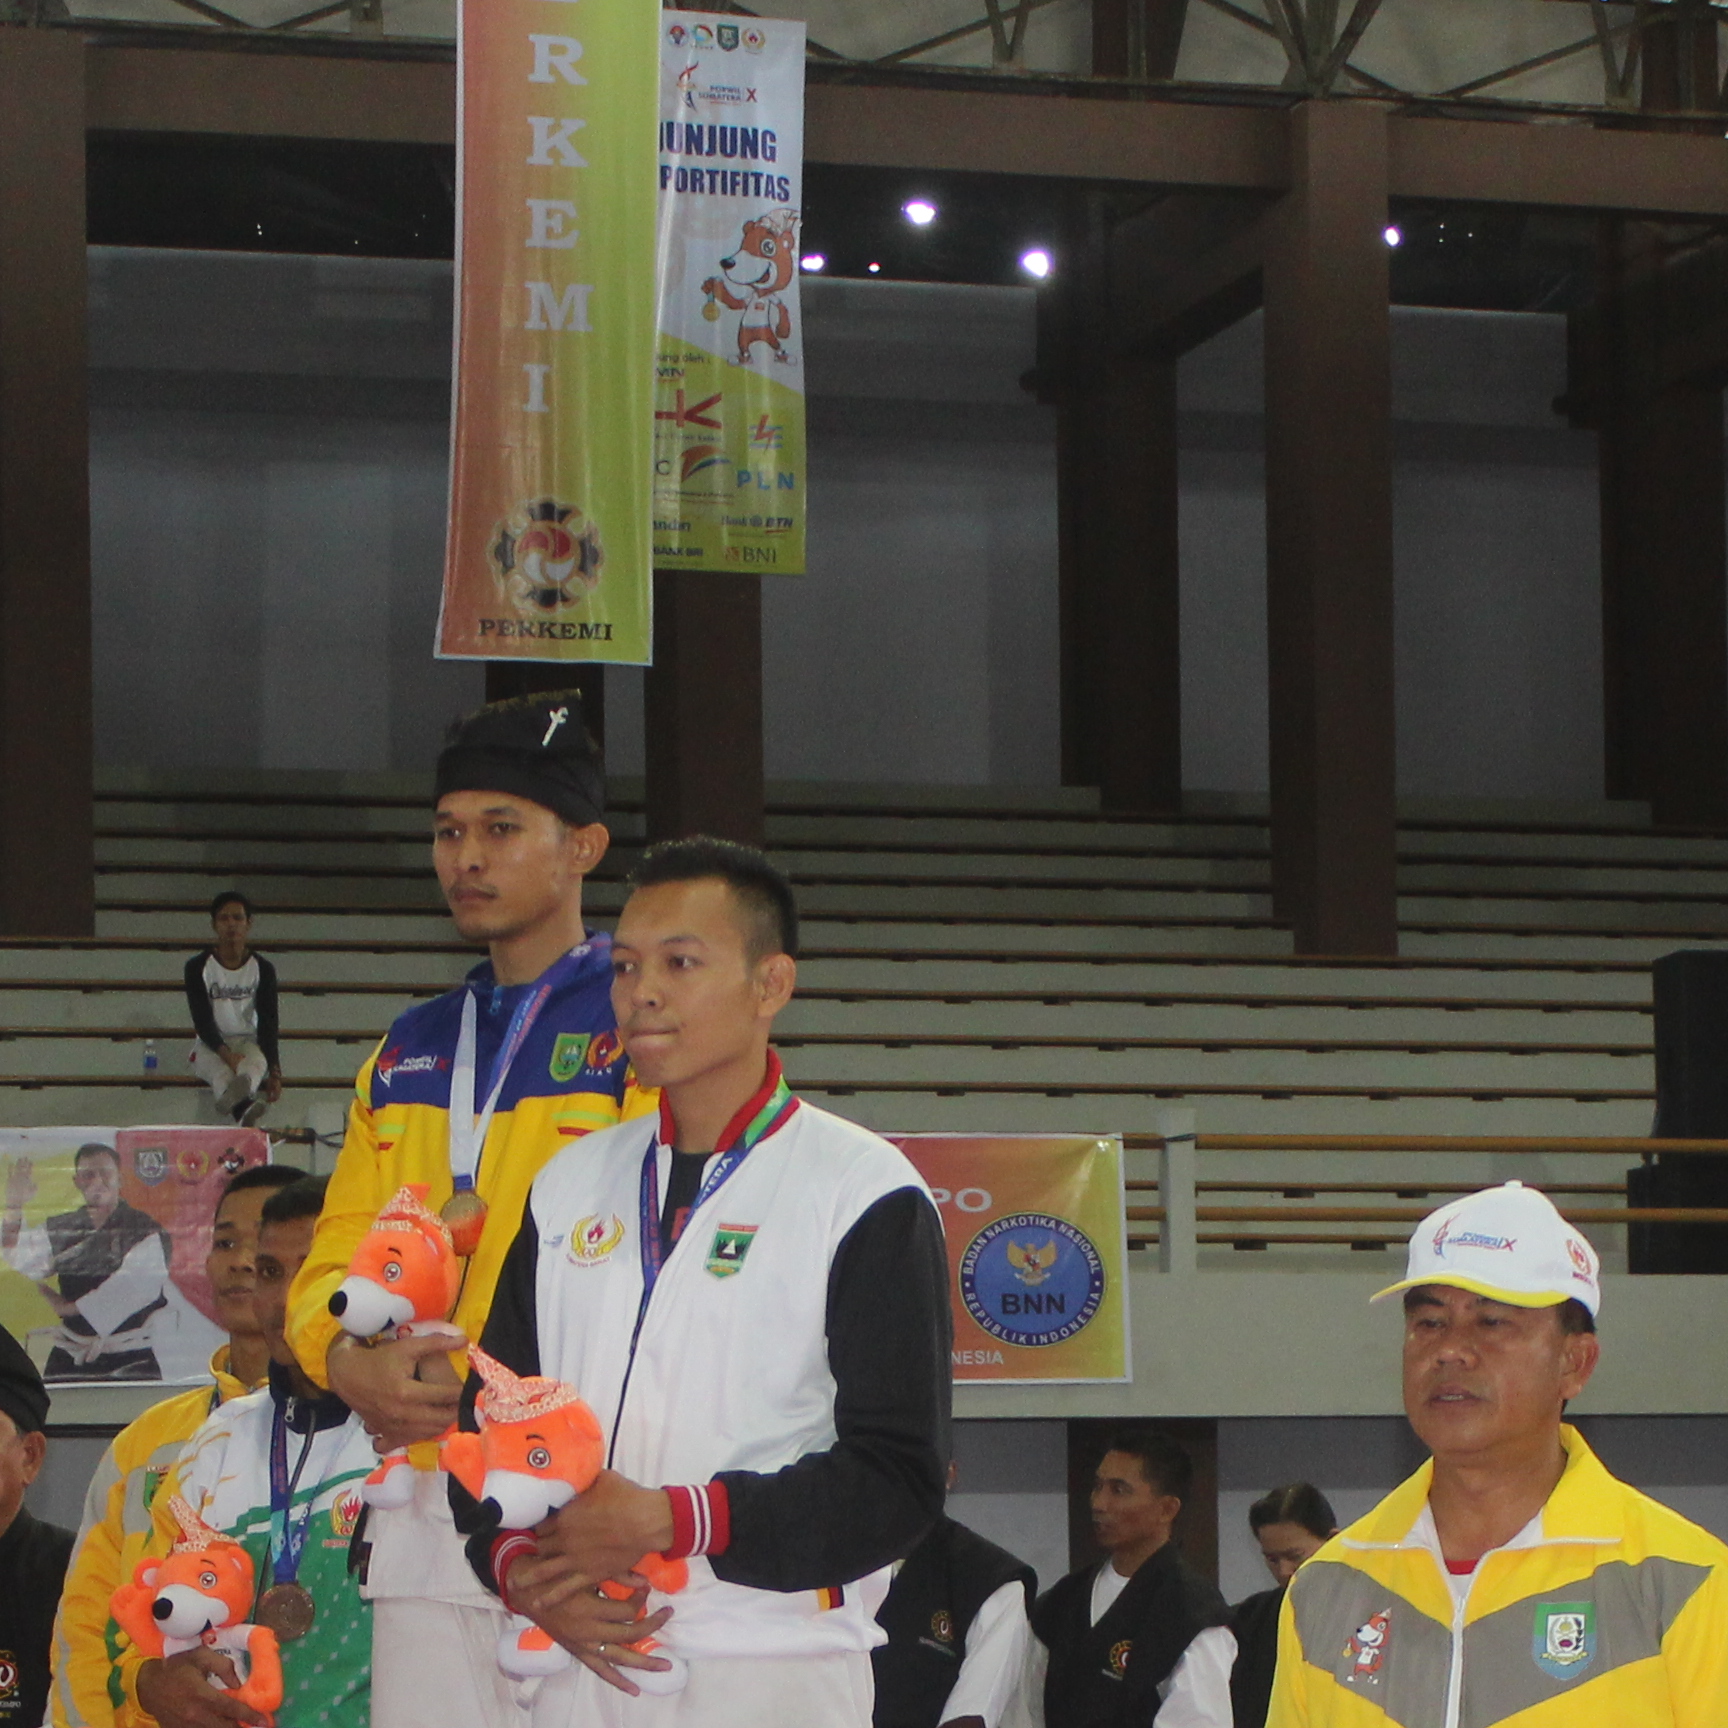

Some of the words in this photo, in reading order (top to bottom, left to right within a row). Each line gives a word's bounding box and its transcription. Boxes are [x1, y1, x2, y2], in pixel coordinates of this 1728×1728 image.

[737, 469, 795, 490] PLN
[743, 546, 777, 563] BNI
[477, 618, 614, 642] PERKEMI
[962, 1235, 988, 1276] BADAN
[986, 1215, 1056, 1239] NARKOTIKA
[1059, 1223, 1101, 1275] NASIONAL
[1001, 1293, 1066, 1315] BNN
[965, 1292, 1027, 1345] REPUBLIK
[1032, 1292, 1100, 1344] INDONESIA
